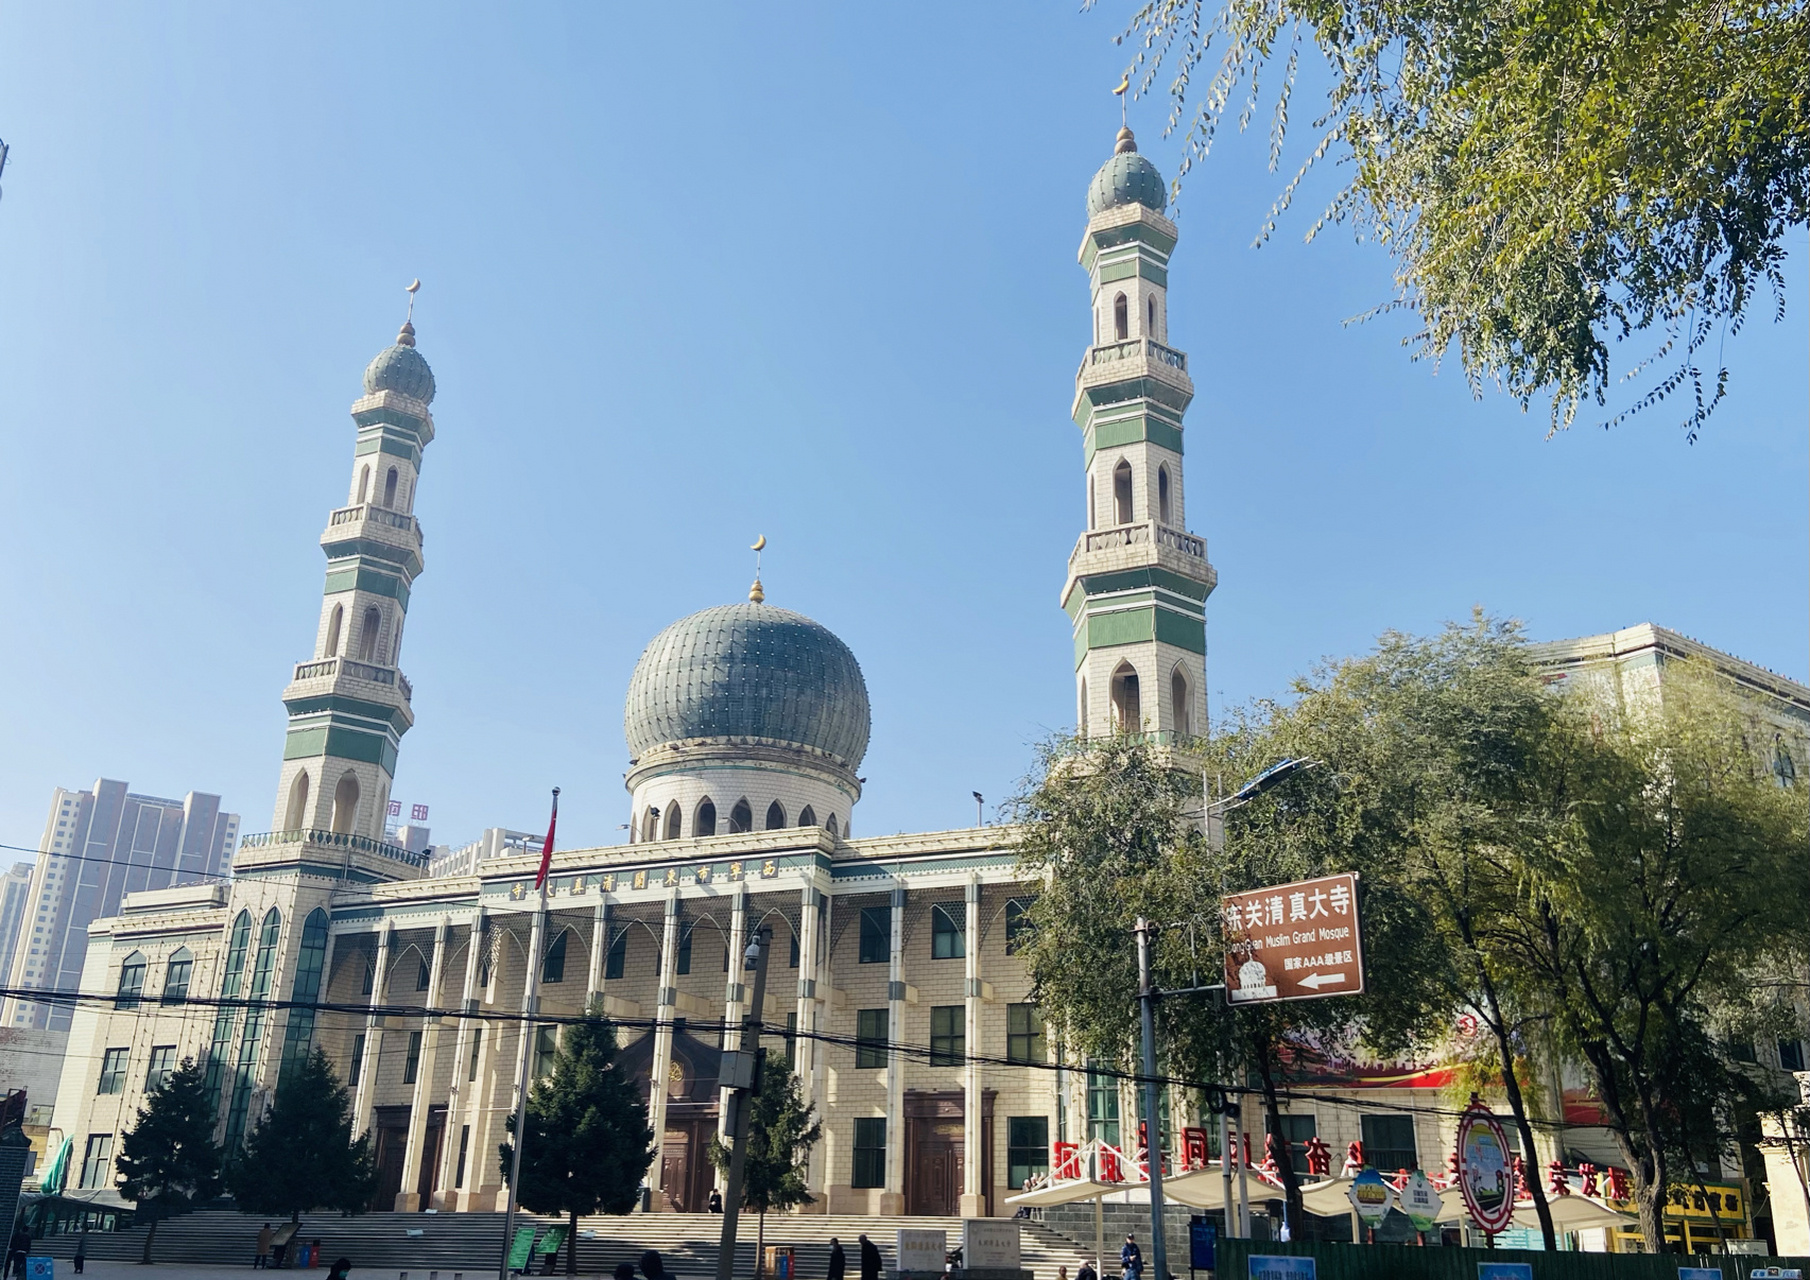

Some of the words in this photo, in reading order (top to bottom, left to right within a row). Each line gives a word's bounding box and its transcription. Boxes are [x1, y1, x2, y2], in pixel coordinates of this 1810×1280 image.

[1226, 884, 1350, 932] 东关清真大寺
[1265, 933, 1291, 949] Muslim
[1292, 928, 1316, 944] Grand
[1318, 926, 1350, 941] Mosque
[1284, 950, 1353, 971] 国家AAA级景区
